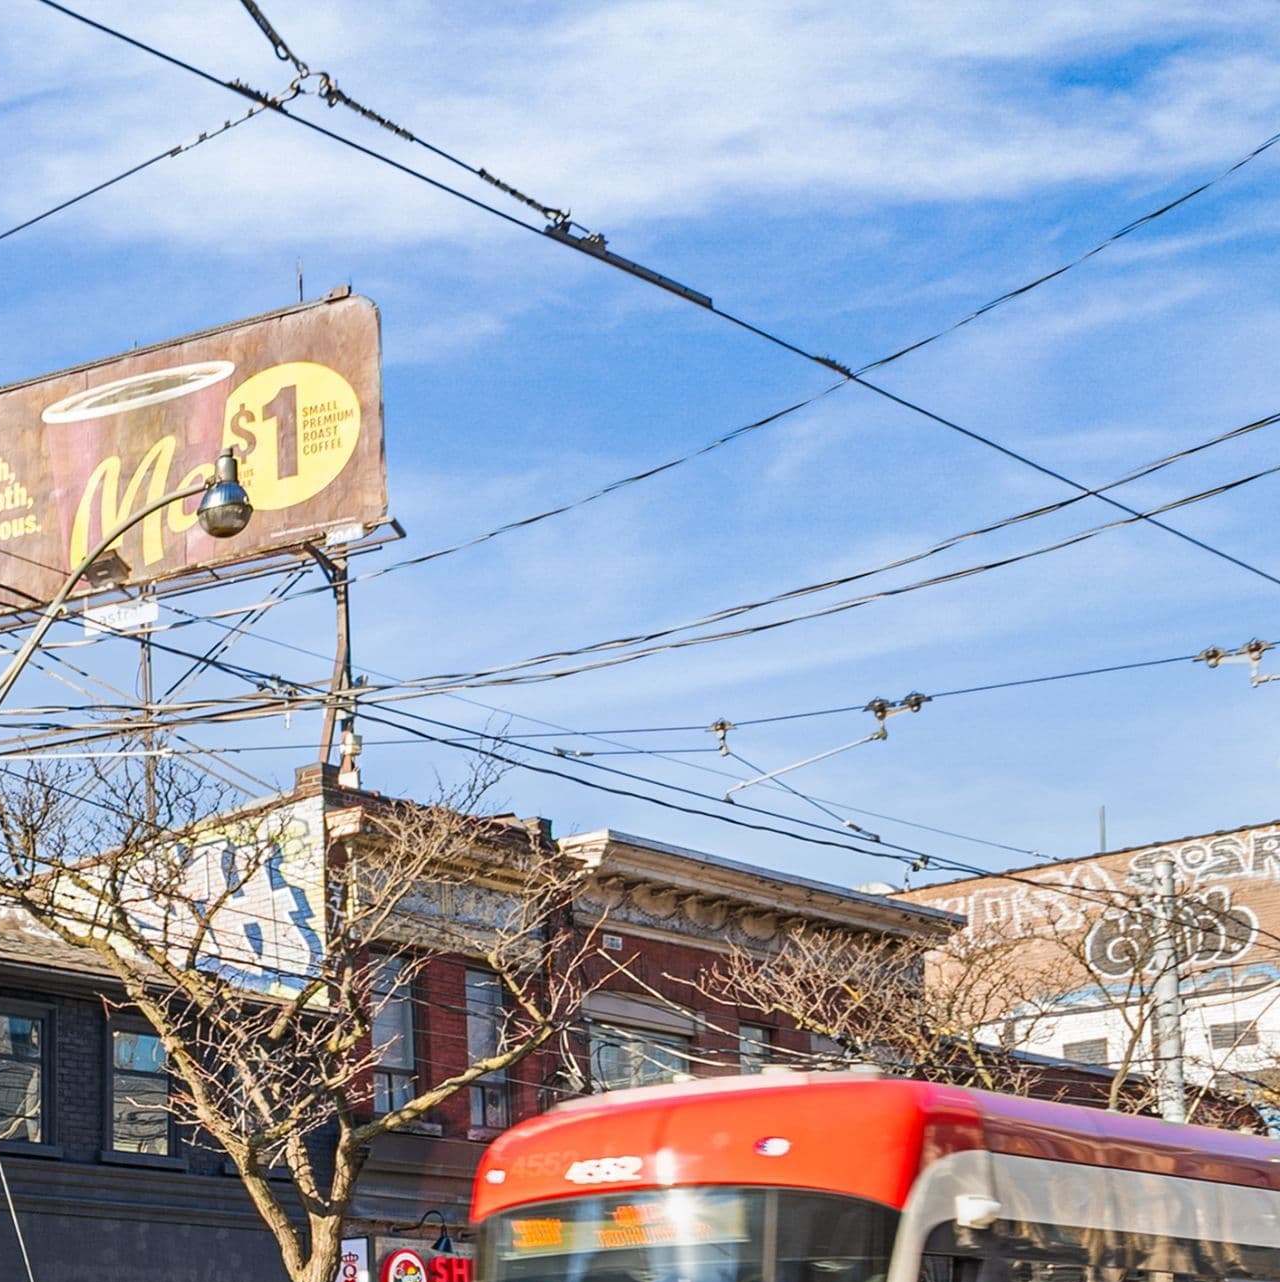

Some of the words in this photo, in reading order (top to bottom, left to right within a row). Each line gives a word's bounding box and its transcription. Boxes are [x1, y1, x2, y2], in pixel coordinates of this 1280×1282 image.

[302, 400, 338, 418] SMALL
[302, 409, 354, 431] PREMIUM
[303, 426, 338, 443] ROAST
[303, 438, 343, 456] COFFEE
